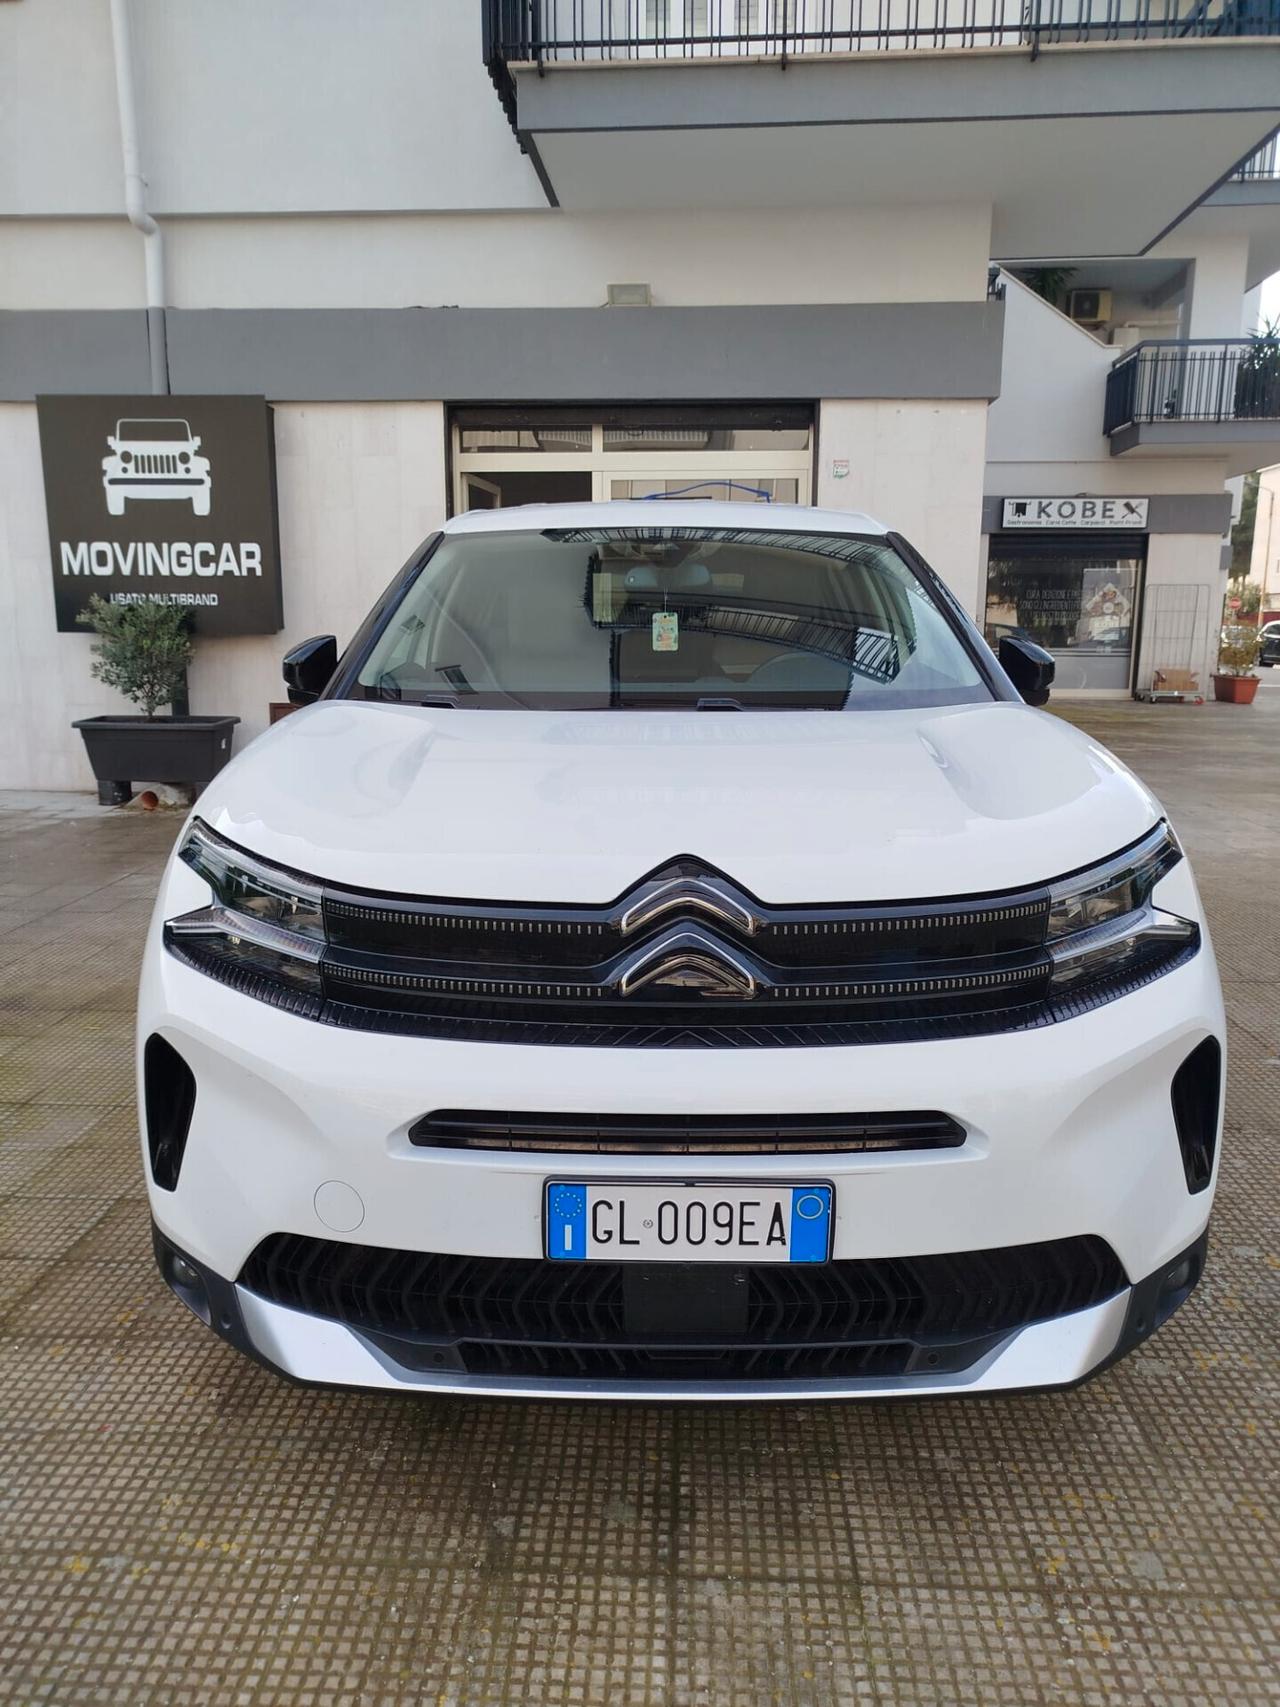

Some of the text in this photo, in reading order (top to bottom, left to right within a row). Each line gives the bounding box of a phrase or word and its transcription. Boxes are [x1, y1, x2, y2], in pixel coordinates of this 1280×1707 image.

[1037, 500, 1116, 519] KOBE
[60, 541, 263, 577] MOVINGCAR
[110, 593, 219, 606] USATO MULTIBRAND
